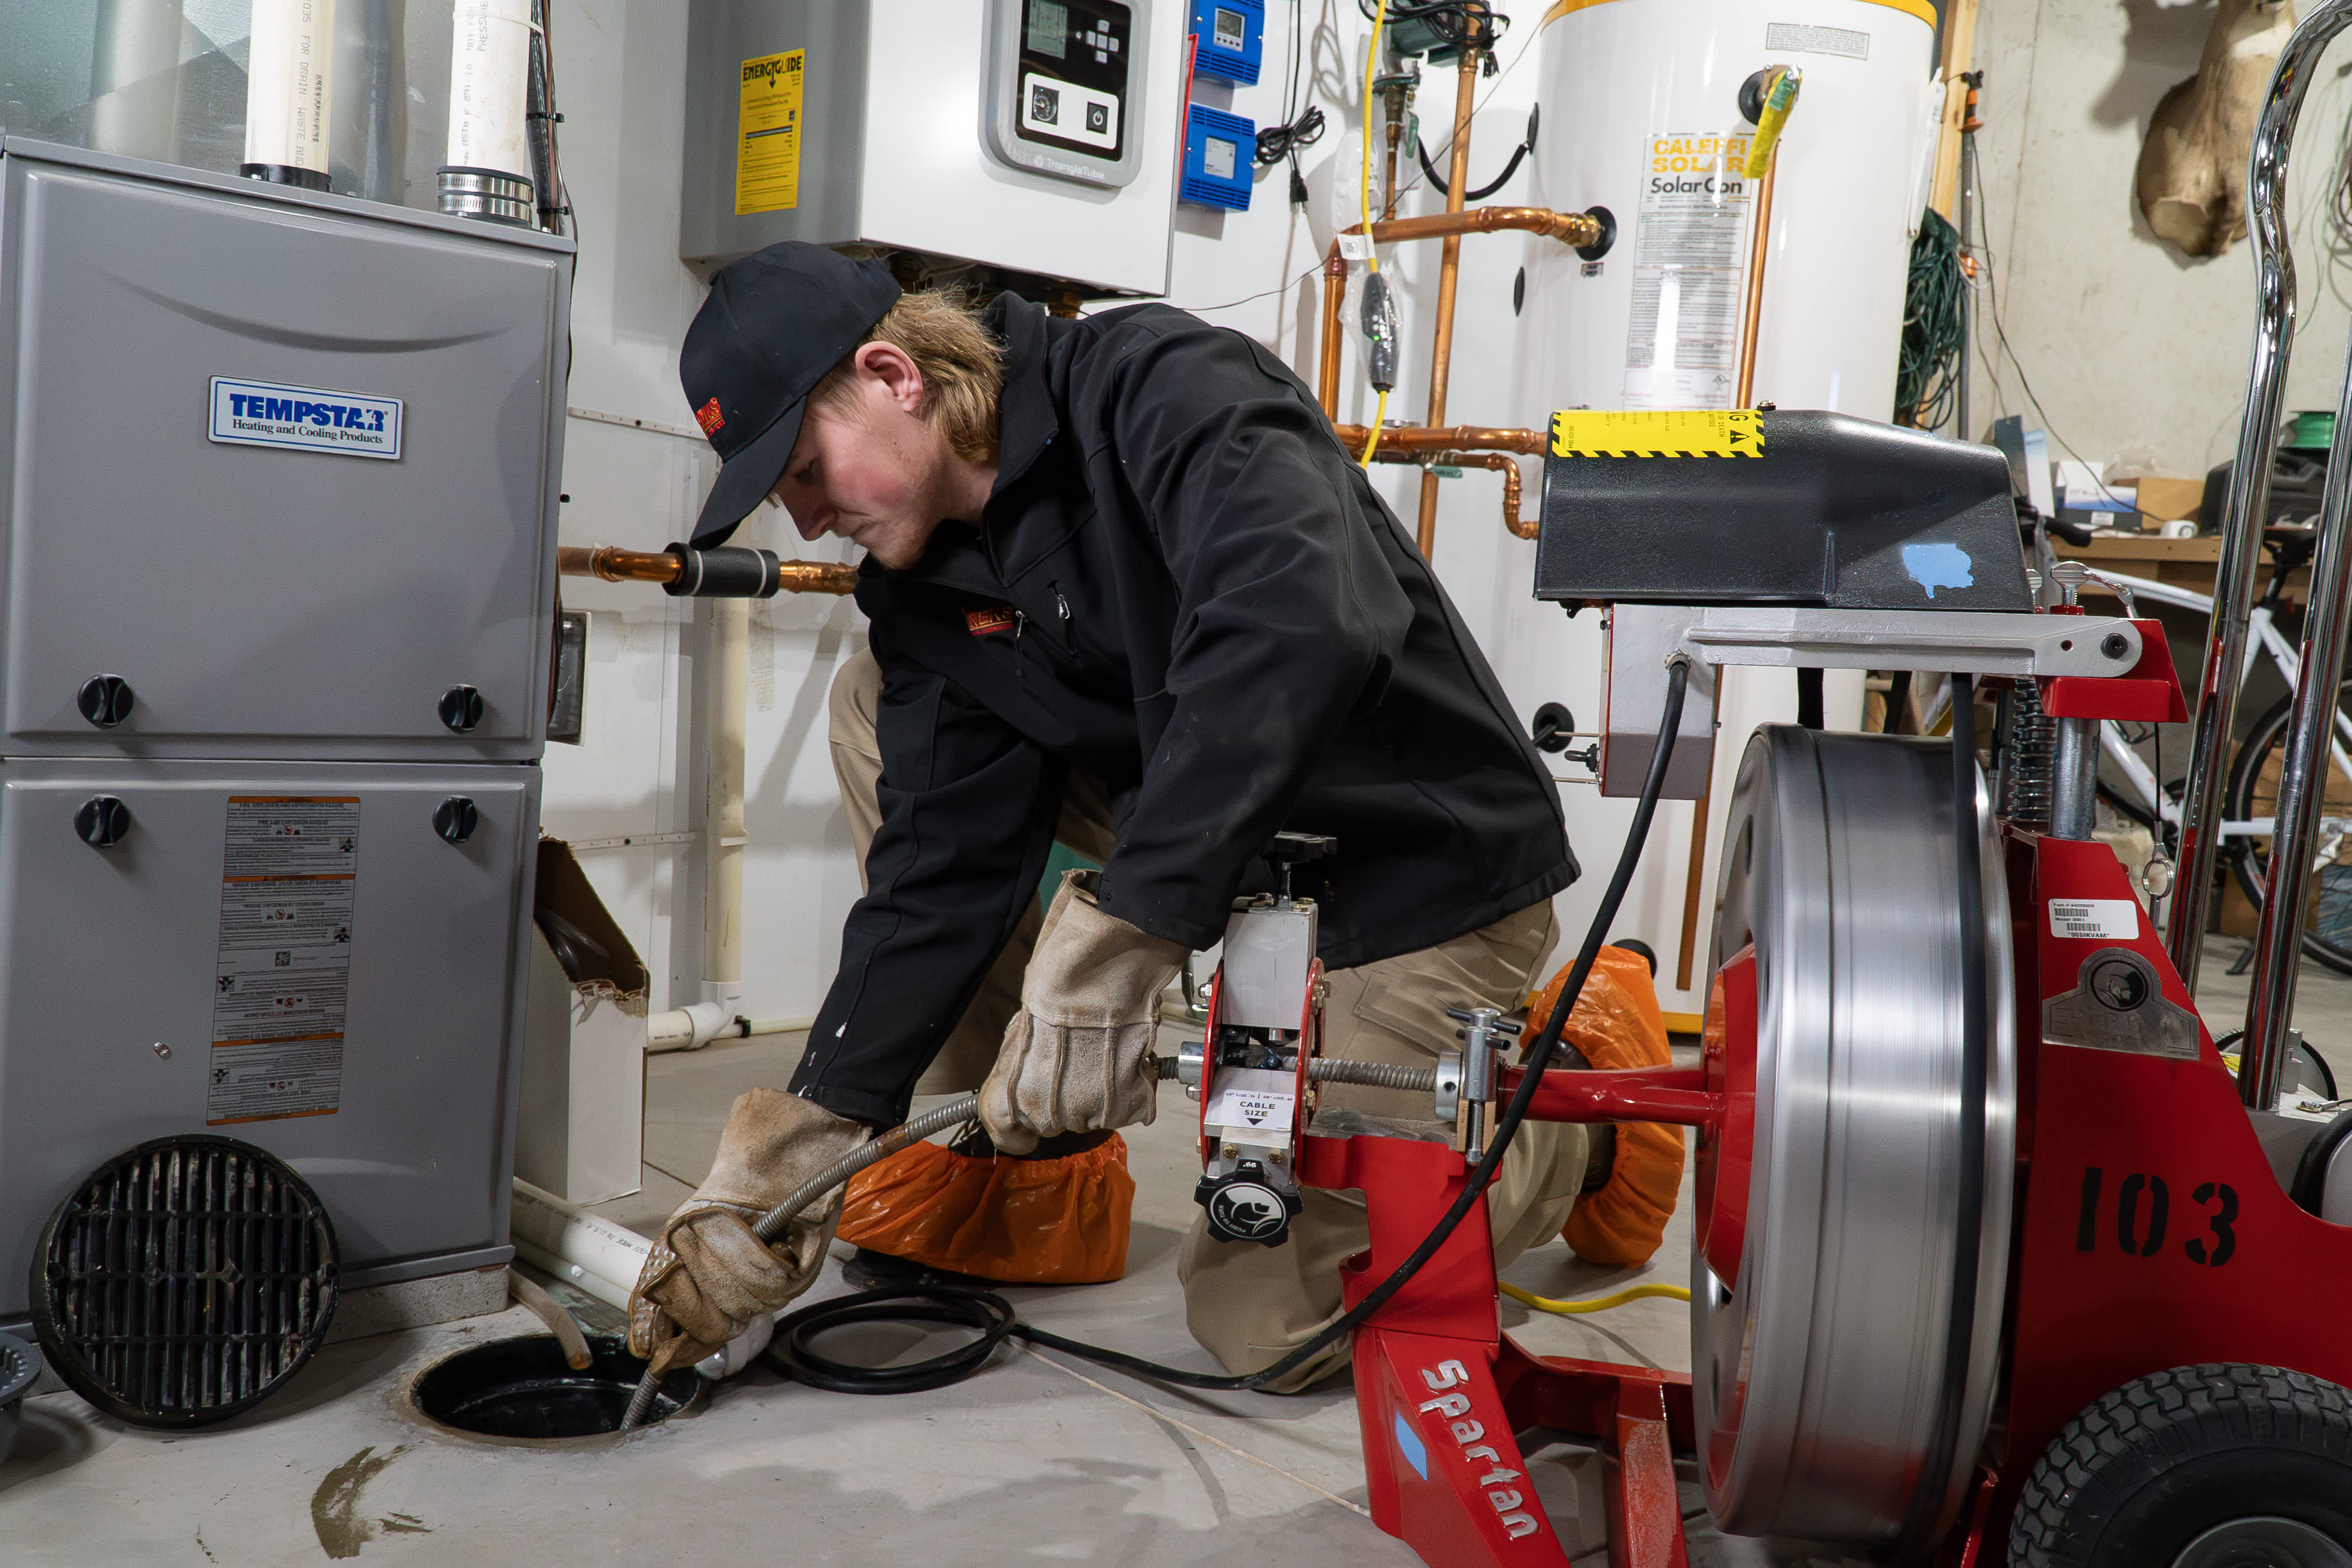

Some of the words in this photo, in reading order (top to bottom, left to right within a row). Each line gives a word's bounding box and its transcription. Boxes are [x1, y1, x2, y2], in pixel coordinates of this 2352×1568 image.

[1650, 176, 1742, 194] SolarCon
[229, 393, 384, 432] TEMPSTAR
[232, 418, 274, 434] Heating
[276, 425, 295, 435] and
[299, 425, 338, 441] Cooling
[340, 430, 384, 445] Products
[1239, 1101, 1276, 1110] CABLE
[2077, 1166, 2239, 1268] 103
[1419, 1359, 1540, 1539] Spartan
